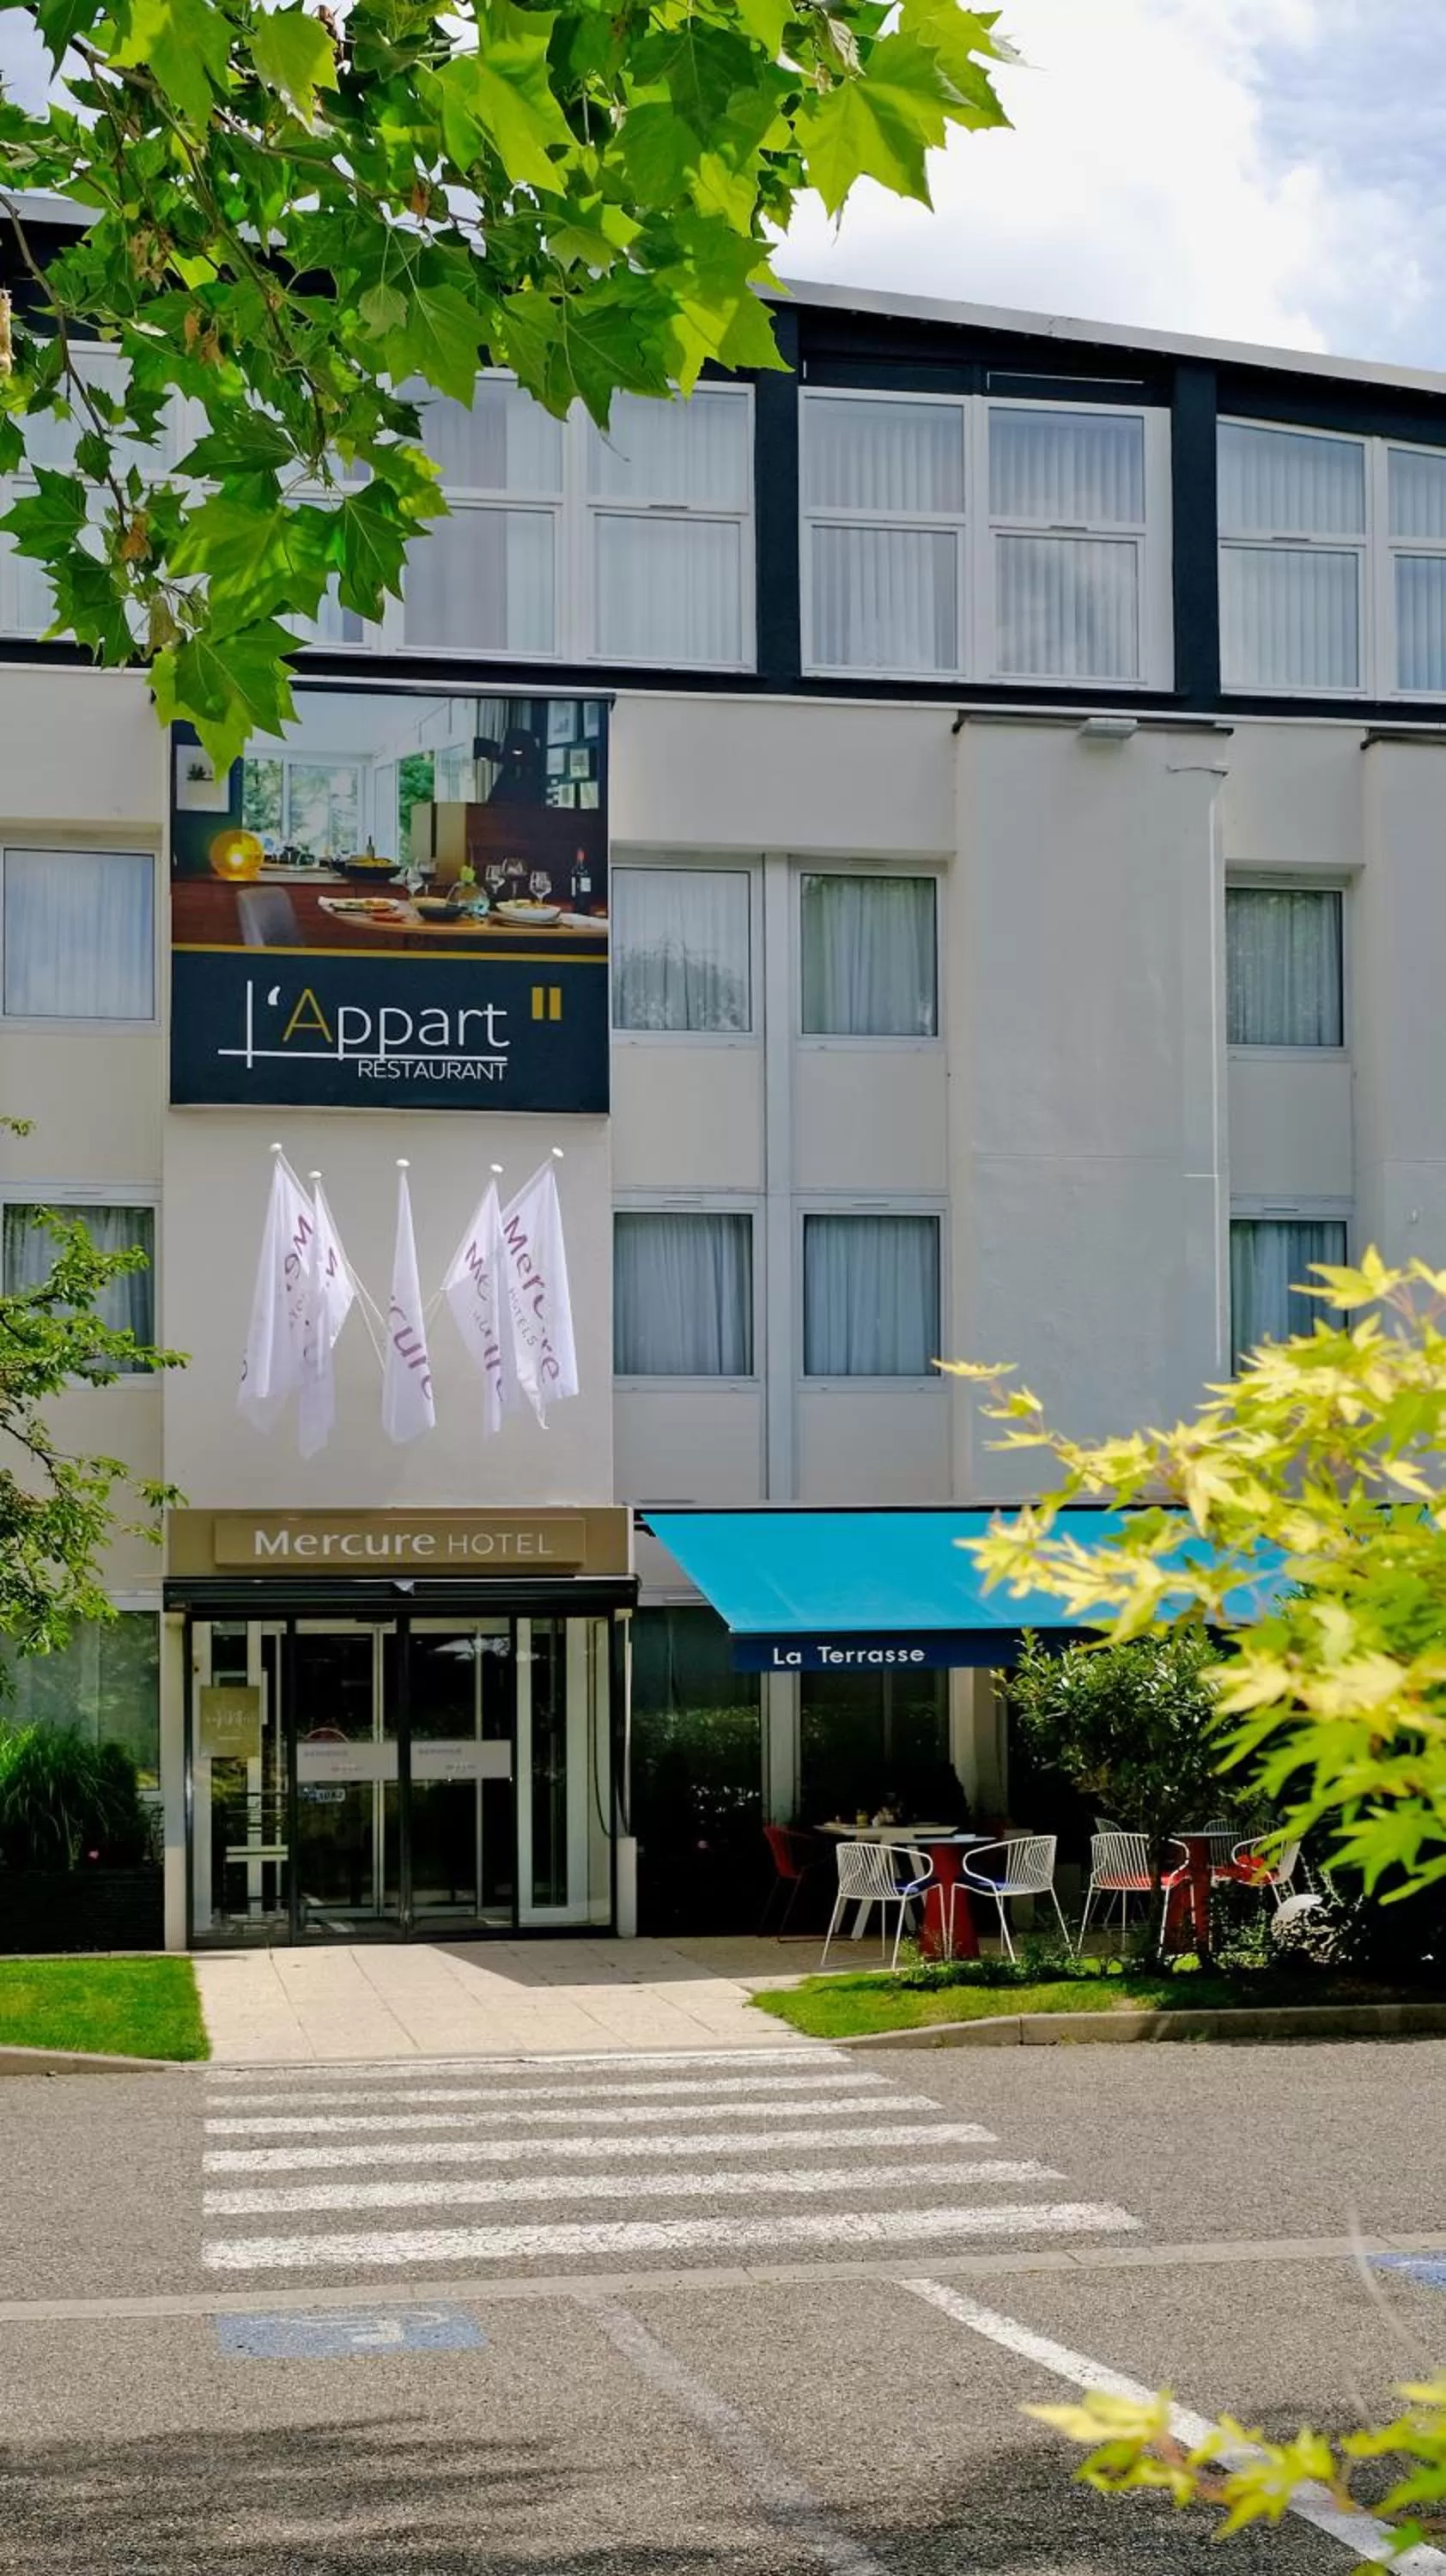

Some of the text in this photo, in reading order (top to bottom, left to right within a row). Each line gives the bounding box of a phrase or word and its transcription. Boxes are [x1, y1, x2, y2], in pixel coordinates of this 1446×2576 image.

[357, 1060, 508, 1081] RESTAURANT
[254, 1529, 554, 1556] Mercure HOTEL
[773, 1645, 926, 1665] La Terrasse
